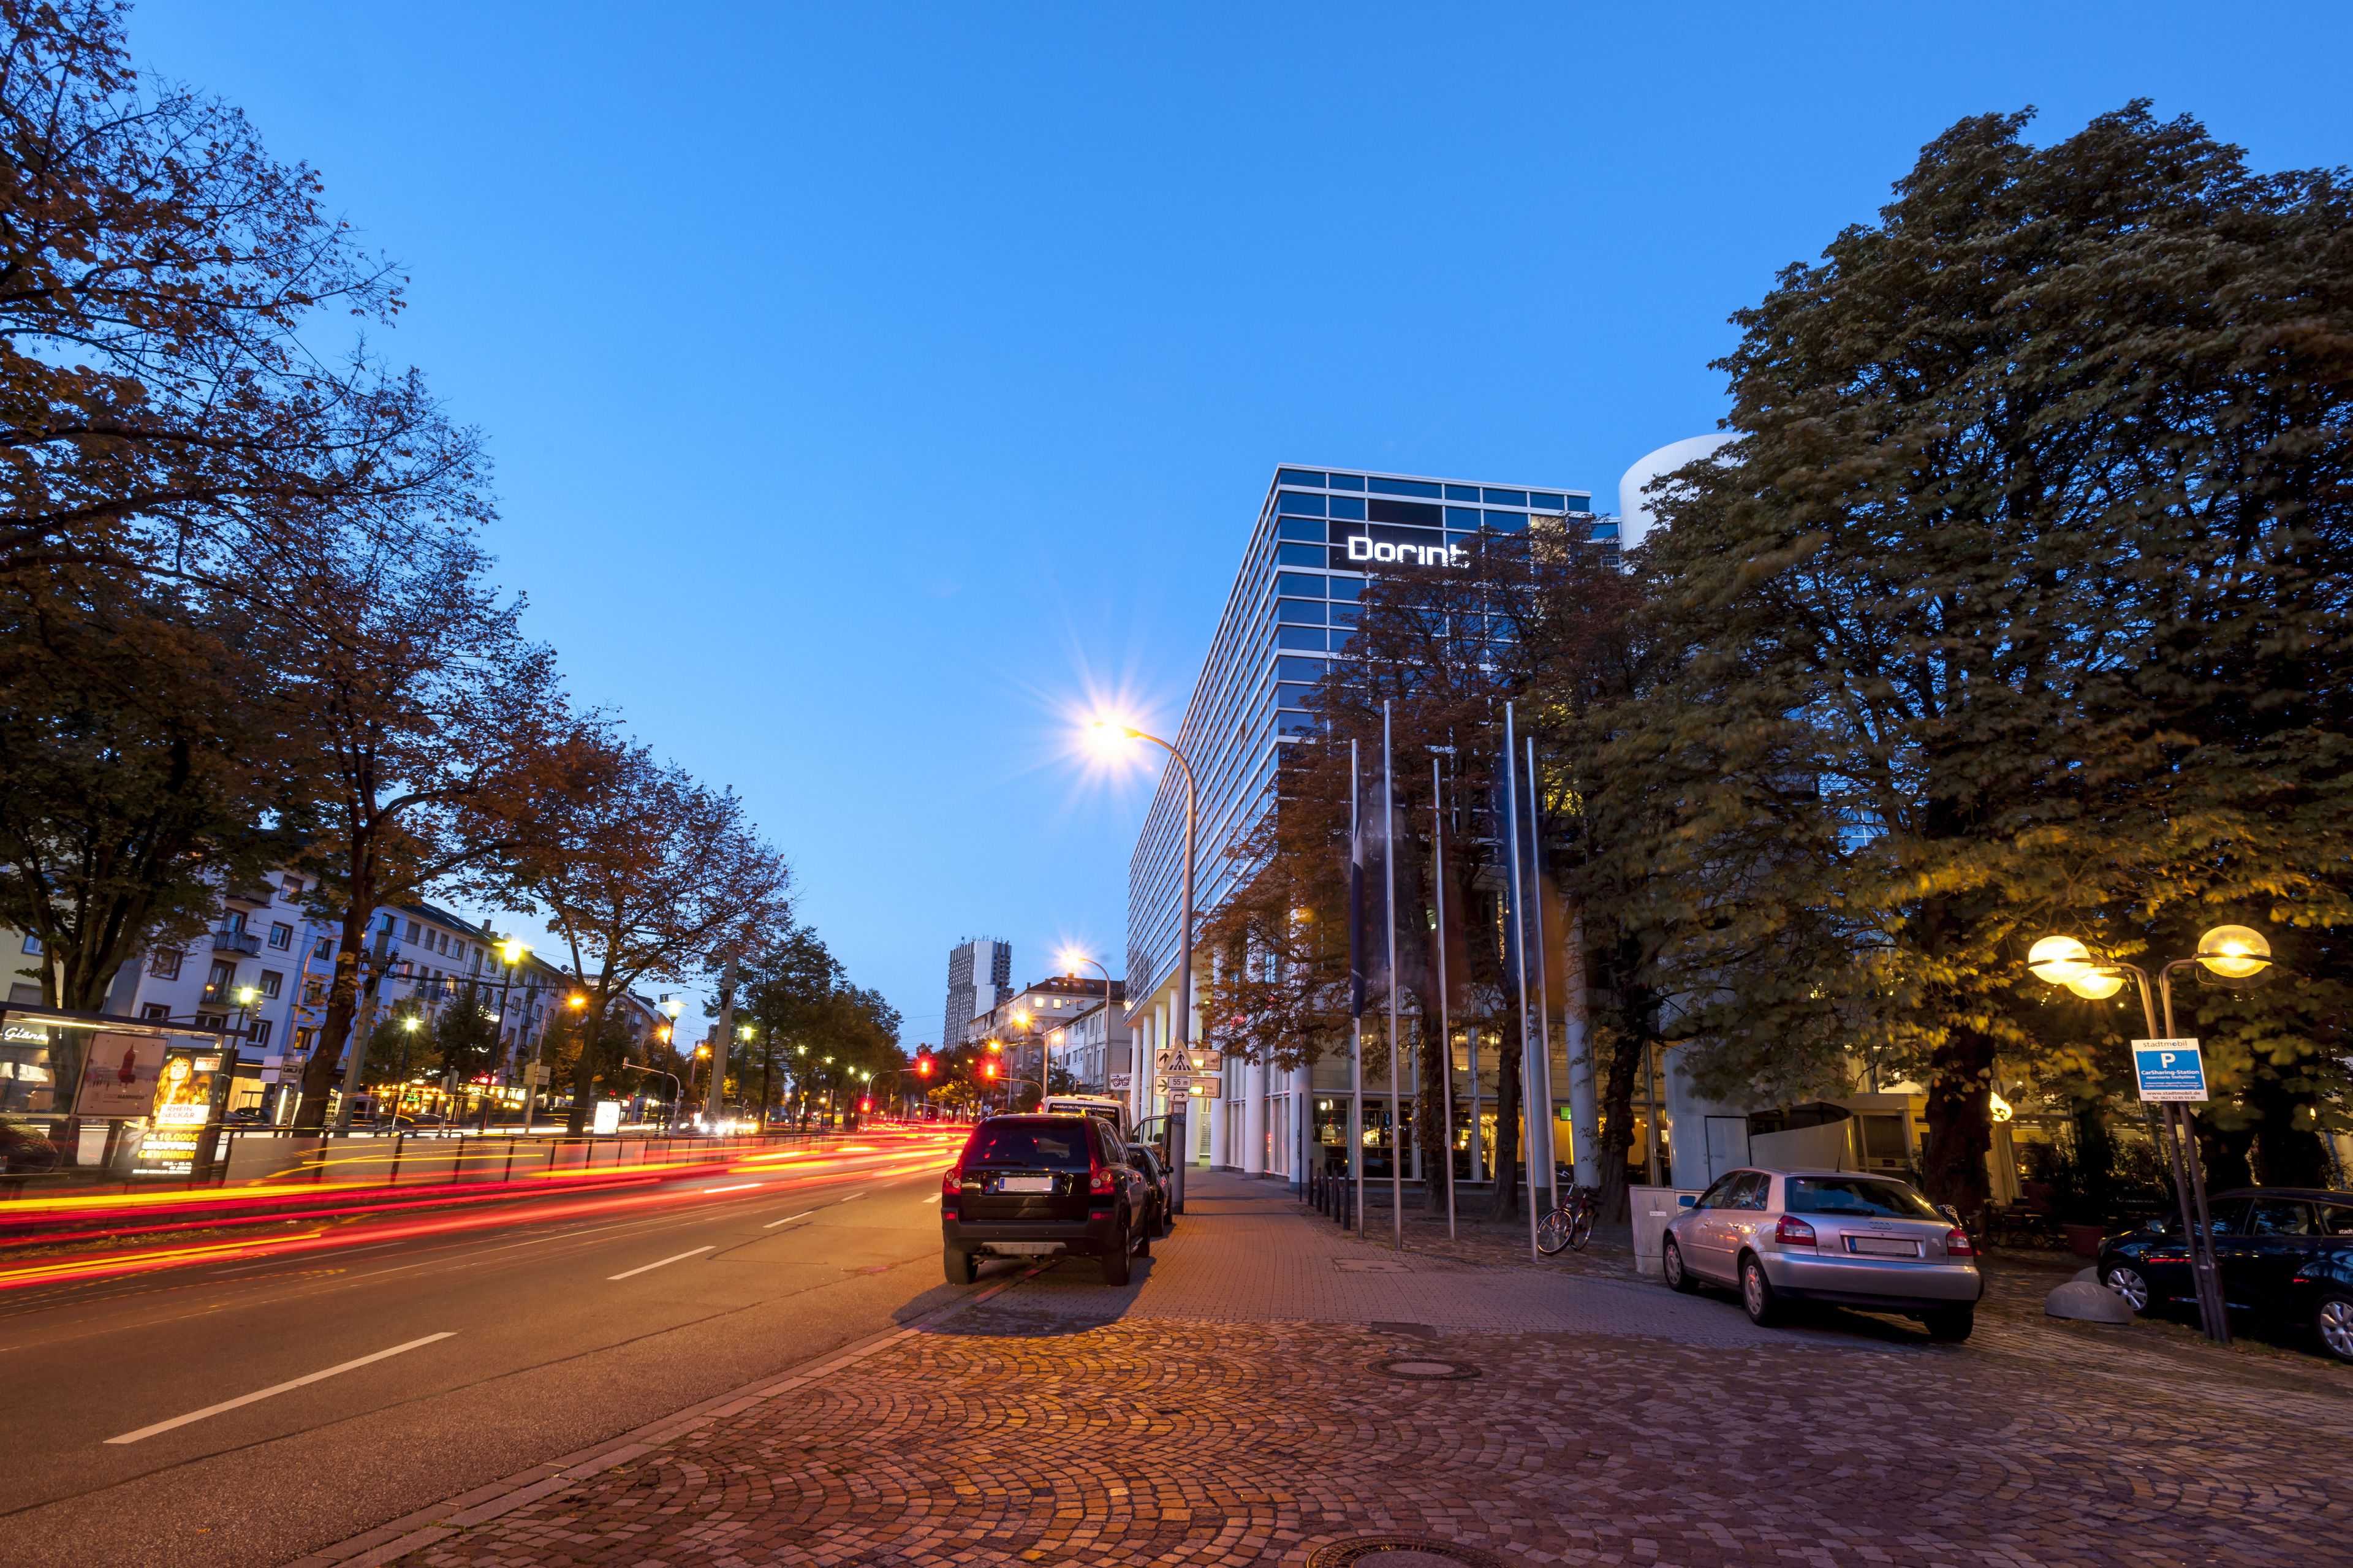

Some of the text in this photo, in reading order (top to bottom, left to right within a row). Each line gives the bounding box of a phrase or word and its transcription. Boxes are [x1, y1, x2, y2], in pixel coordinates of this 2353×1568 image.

[1348, 536, 1470, 569] Dorint
[4, 1028, 49, 1040] Giann
[2161, 1053, 2176, 1068] P
[158, 1132, 199, 1142] 10.000€
[142, 1141, 197, 1150] SHOPPING
[137, 1149, 195, 1159] GEWINNEN
